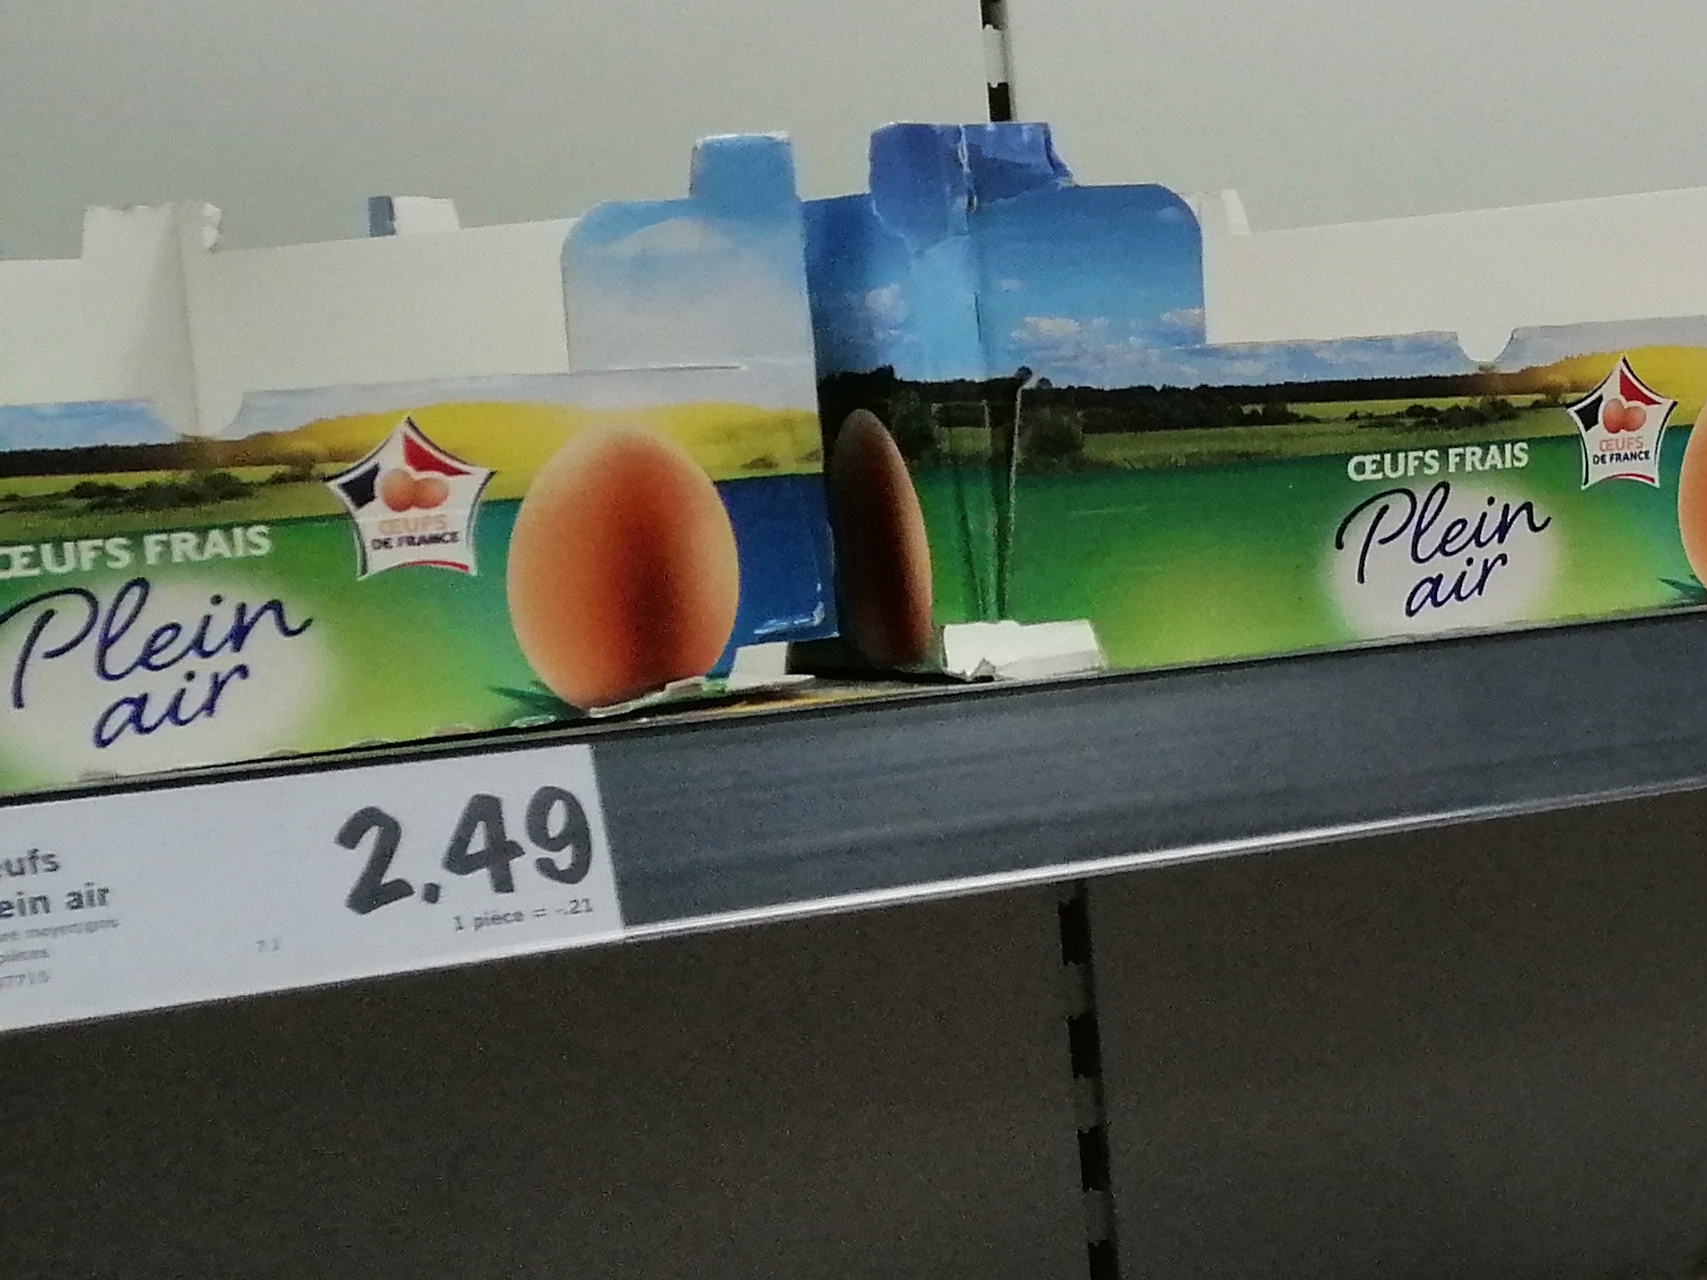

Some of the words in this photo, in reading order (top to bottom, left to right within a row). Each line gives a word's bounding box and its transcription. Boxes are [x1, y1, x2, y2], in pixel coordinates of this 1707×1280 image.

[1348, 449, 1440, 482] ŒUFS
[1448, 442, 1529, 474] FRAIS
[1592, 453, 1608, 466] DE
[1611, 448, 1651, 464] FRANCE
[1599, 435, 1644, 453] ŒUFS
[145, 525, 272, 567] FRAIS
[371, 535, 393, 550] DE
[397, 530, 460, 548] FRANCE
[1335, 481, 1551, 584] Plein
[1405, 553, 1508, 618] air
[0, 577, 313, 708] Plein
[93, 665, 251, 750] air
[335, 785, 593, 916] 2.49
[65, 881, 110, 910] air
